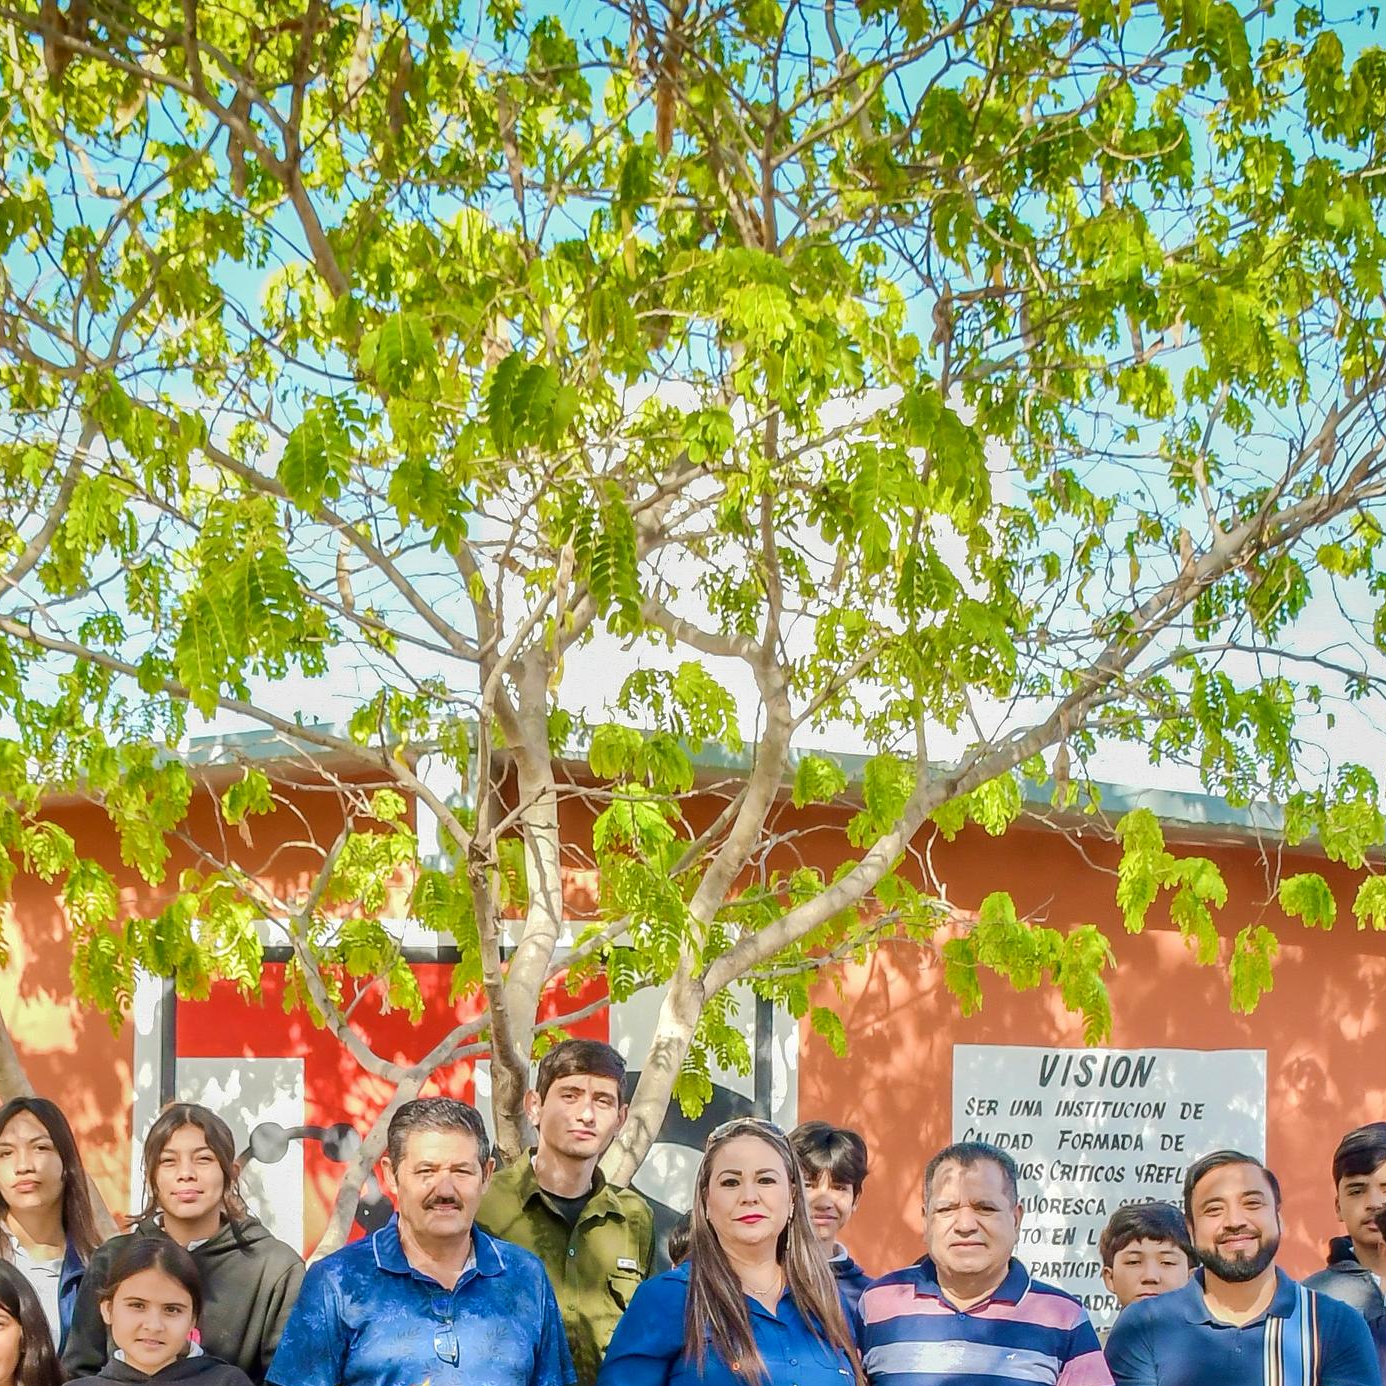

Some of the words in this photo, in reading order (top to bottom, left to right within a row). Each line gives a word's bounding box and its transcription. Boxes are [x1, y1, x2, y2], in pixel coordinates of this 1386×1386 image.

[1038, 1054, 1156, 1089] VISION
[965, 1097, 998, 1117] SER
[1009, 1099, 1043, 1117] UNA
[1054, 1100, 1166, 1119] INSTITUCION
[1180, 1102, 1205, 1121] DE
[1058, 1130, 1144, 1151] FORMADA
[1160, 1134, 1185, 1152] DE
[1049, 1159, 1125, 1183] CRITICOS
[1051, 1226, 1077, 1246] EN
[1030, 1261, 1103, 1279] PARTICIP
